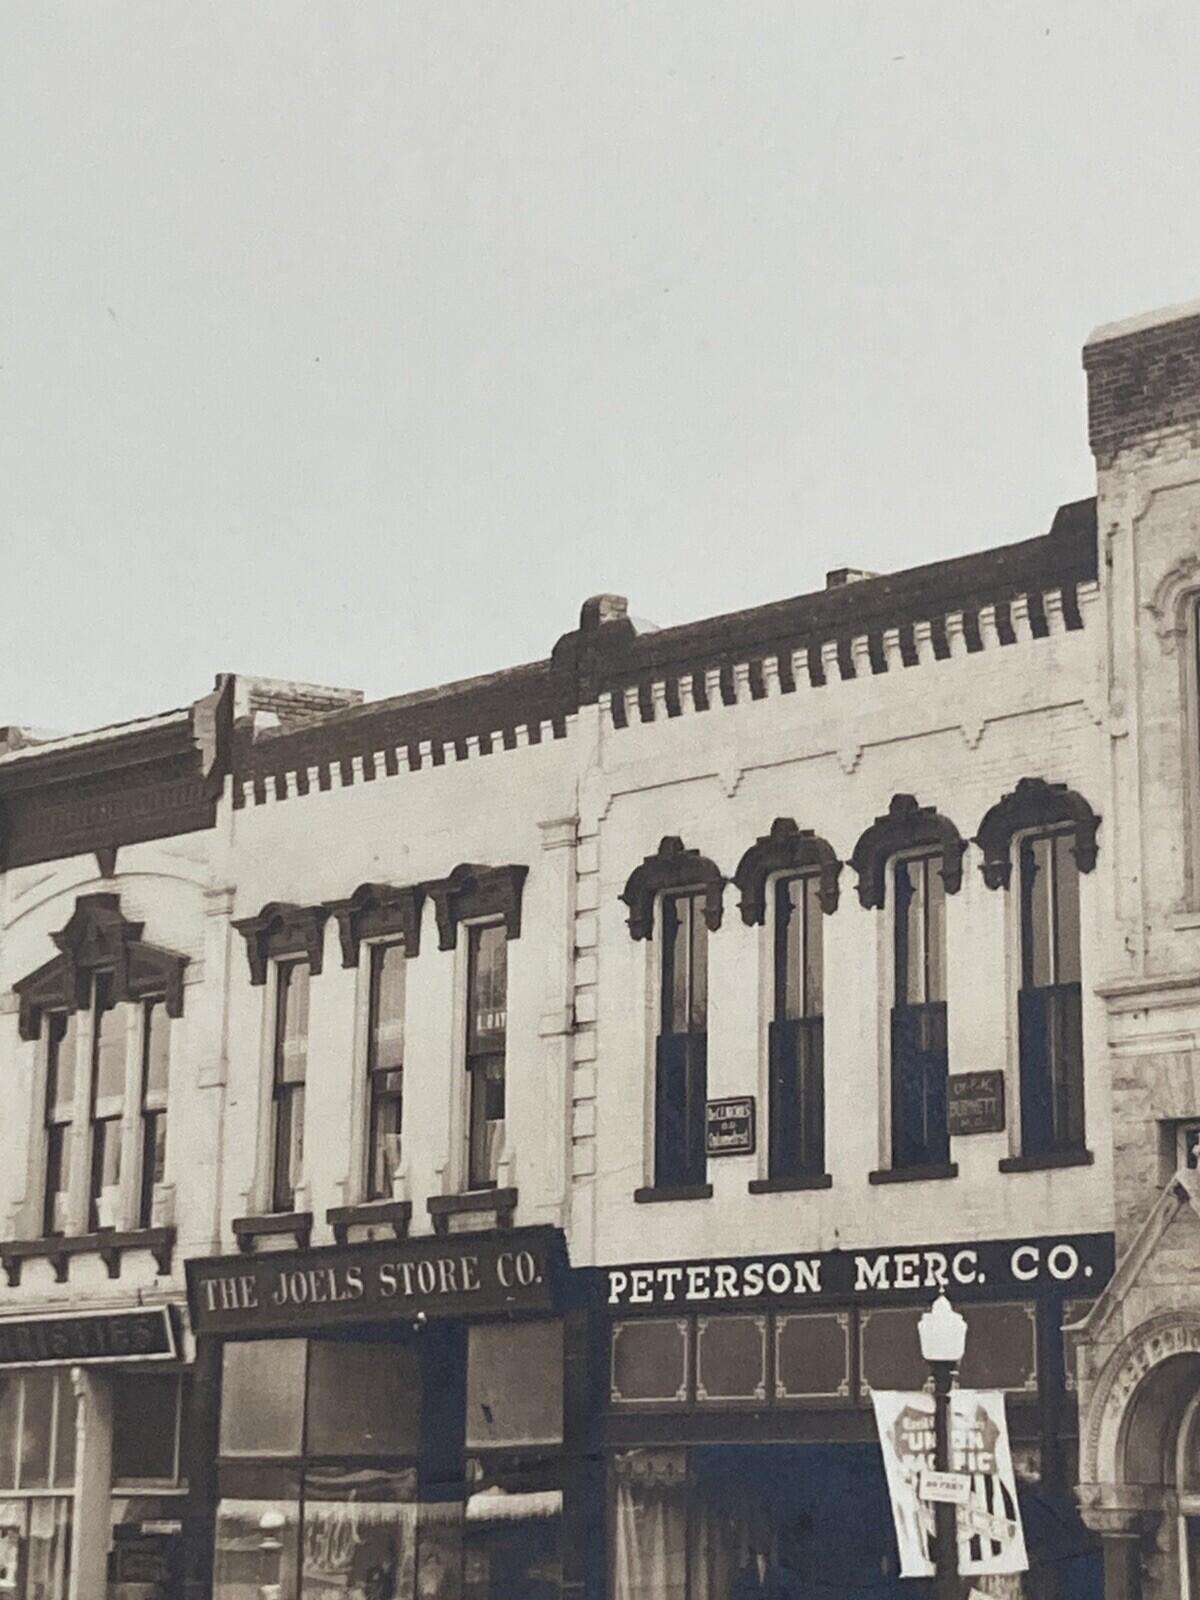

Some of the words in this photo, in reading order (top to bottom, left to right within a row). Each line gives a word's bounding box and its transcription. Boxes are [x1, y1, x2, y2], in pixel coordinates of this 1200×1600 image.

[201, 1275, 259, 1311] THE
[272, 1266, 364, 1306] JOELS
[379, 1255, 481, 1297] STORE
[497, 1249, 543, 1288] CO.
[607, 1259, 822, 1304] PETERSON
[853, 1249, 986, 1291] MERC.
[1010, 1244, 1094, 1281] CO.
